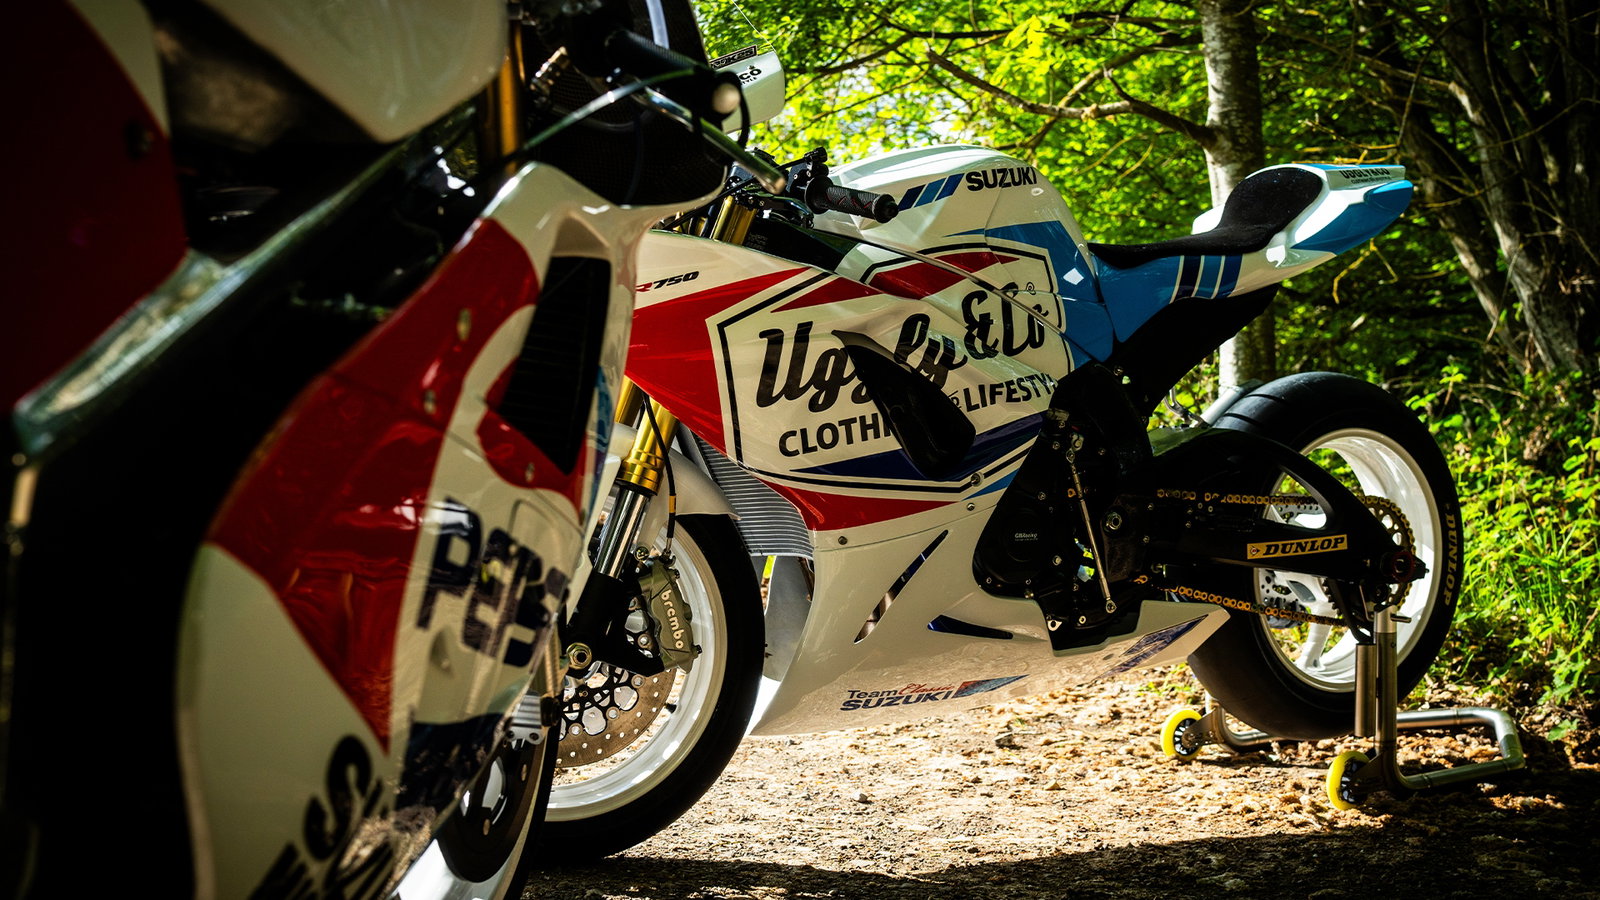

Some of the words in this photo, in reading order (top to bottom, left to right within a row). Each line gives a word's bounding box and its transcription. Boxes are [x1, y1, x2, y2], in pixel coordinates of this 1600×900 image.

[965, 166, 1038, 191] SUZUKI
[1263, 536, 1345, 556] DUNLOP
[1443, 512, 1459, 607] DUNLOP
[660, 589, 685, 649] brembo
[839, 690, 954, 711] SUZUKI
[847, 689, 898, 699] Team
[898, 682, 955, 695] Classic
